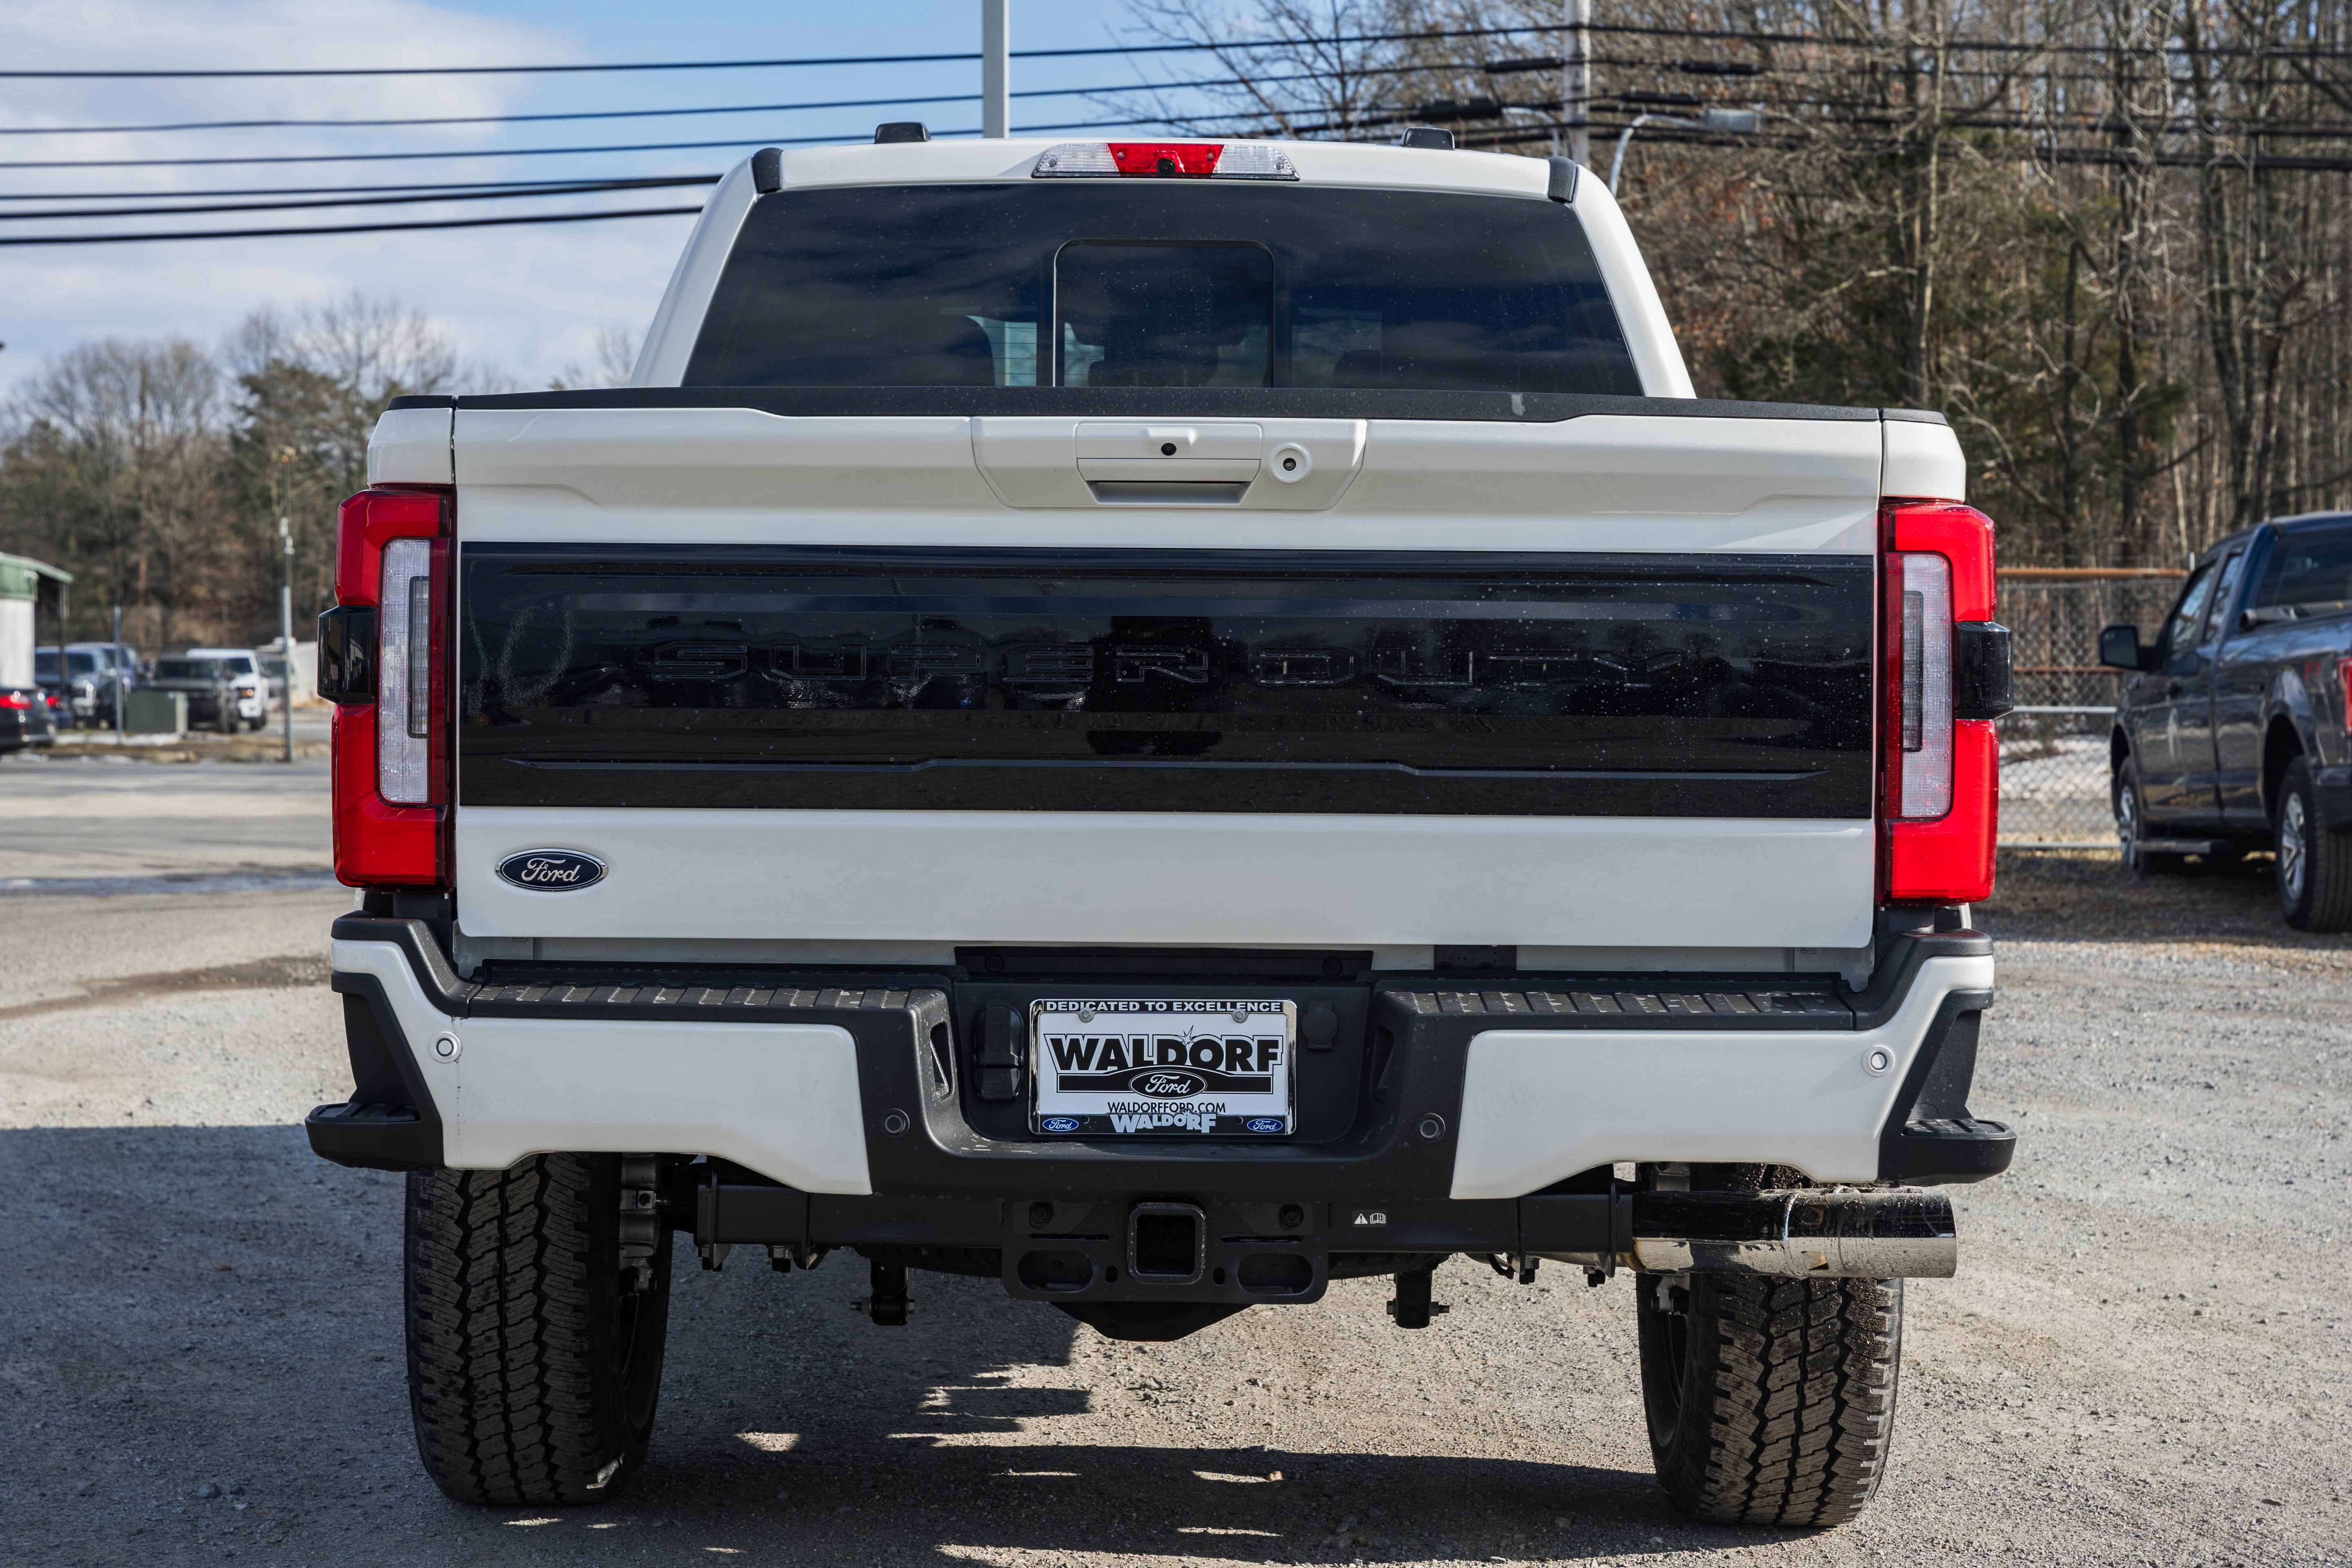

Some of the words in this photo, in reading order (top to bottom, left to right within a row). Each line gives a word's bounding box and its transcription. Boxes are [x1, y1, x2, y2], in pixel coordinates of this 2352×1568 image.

[654, 641, 1210, 684] SUPER
[1258, 645, 1685, 688] DUTY
[521, 858, 581, 881] Ford
[1047, 1002, 1139, 1011] DEDICATED
[1145, 1002, 1167, 1011] TO
[1173, 1002, 1281, 1011] EXCELLENCE
[1049, 1037, 1280, 1072] WALDORF
[1145, 1074, 1191, 1094] Ford
[1107, 1102, 1226, 1113] WALDORFFORD.COM
[1049, 1119, 1072, 1129] Ford
[1109, 1113, 1216, 1133] WALDORF
[1253, 1120, 1276, 1130] Ford
